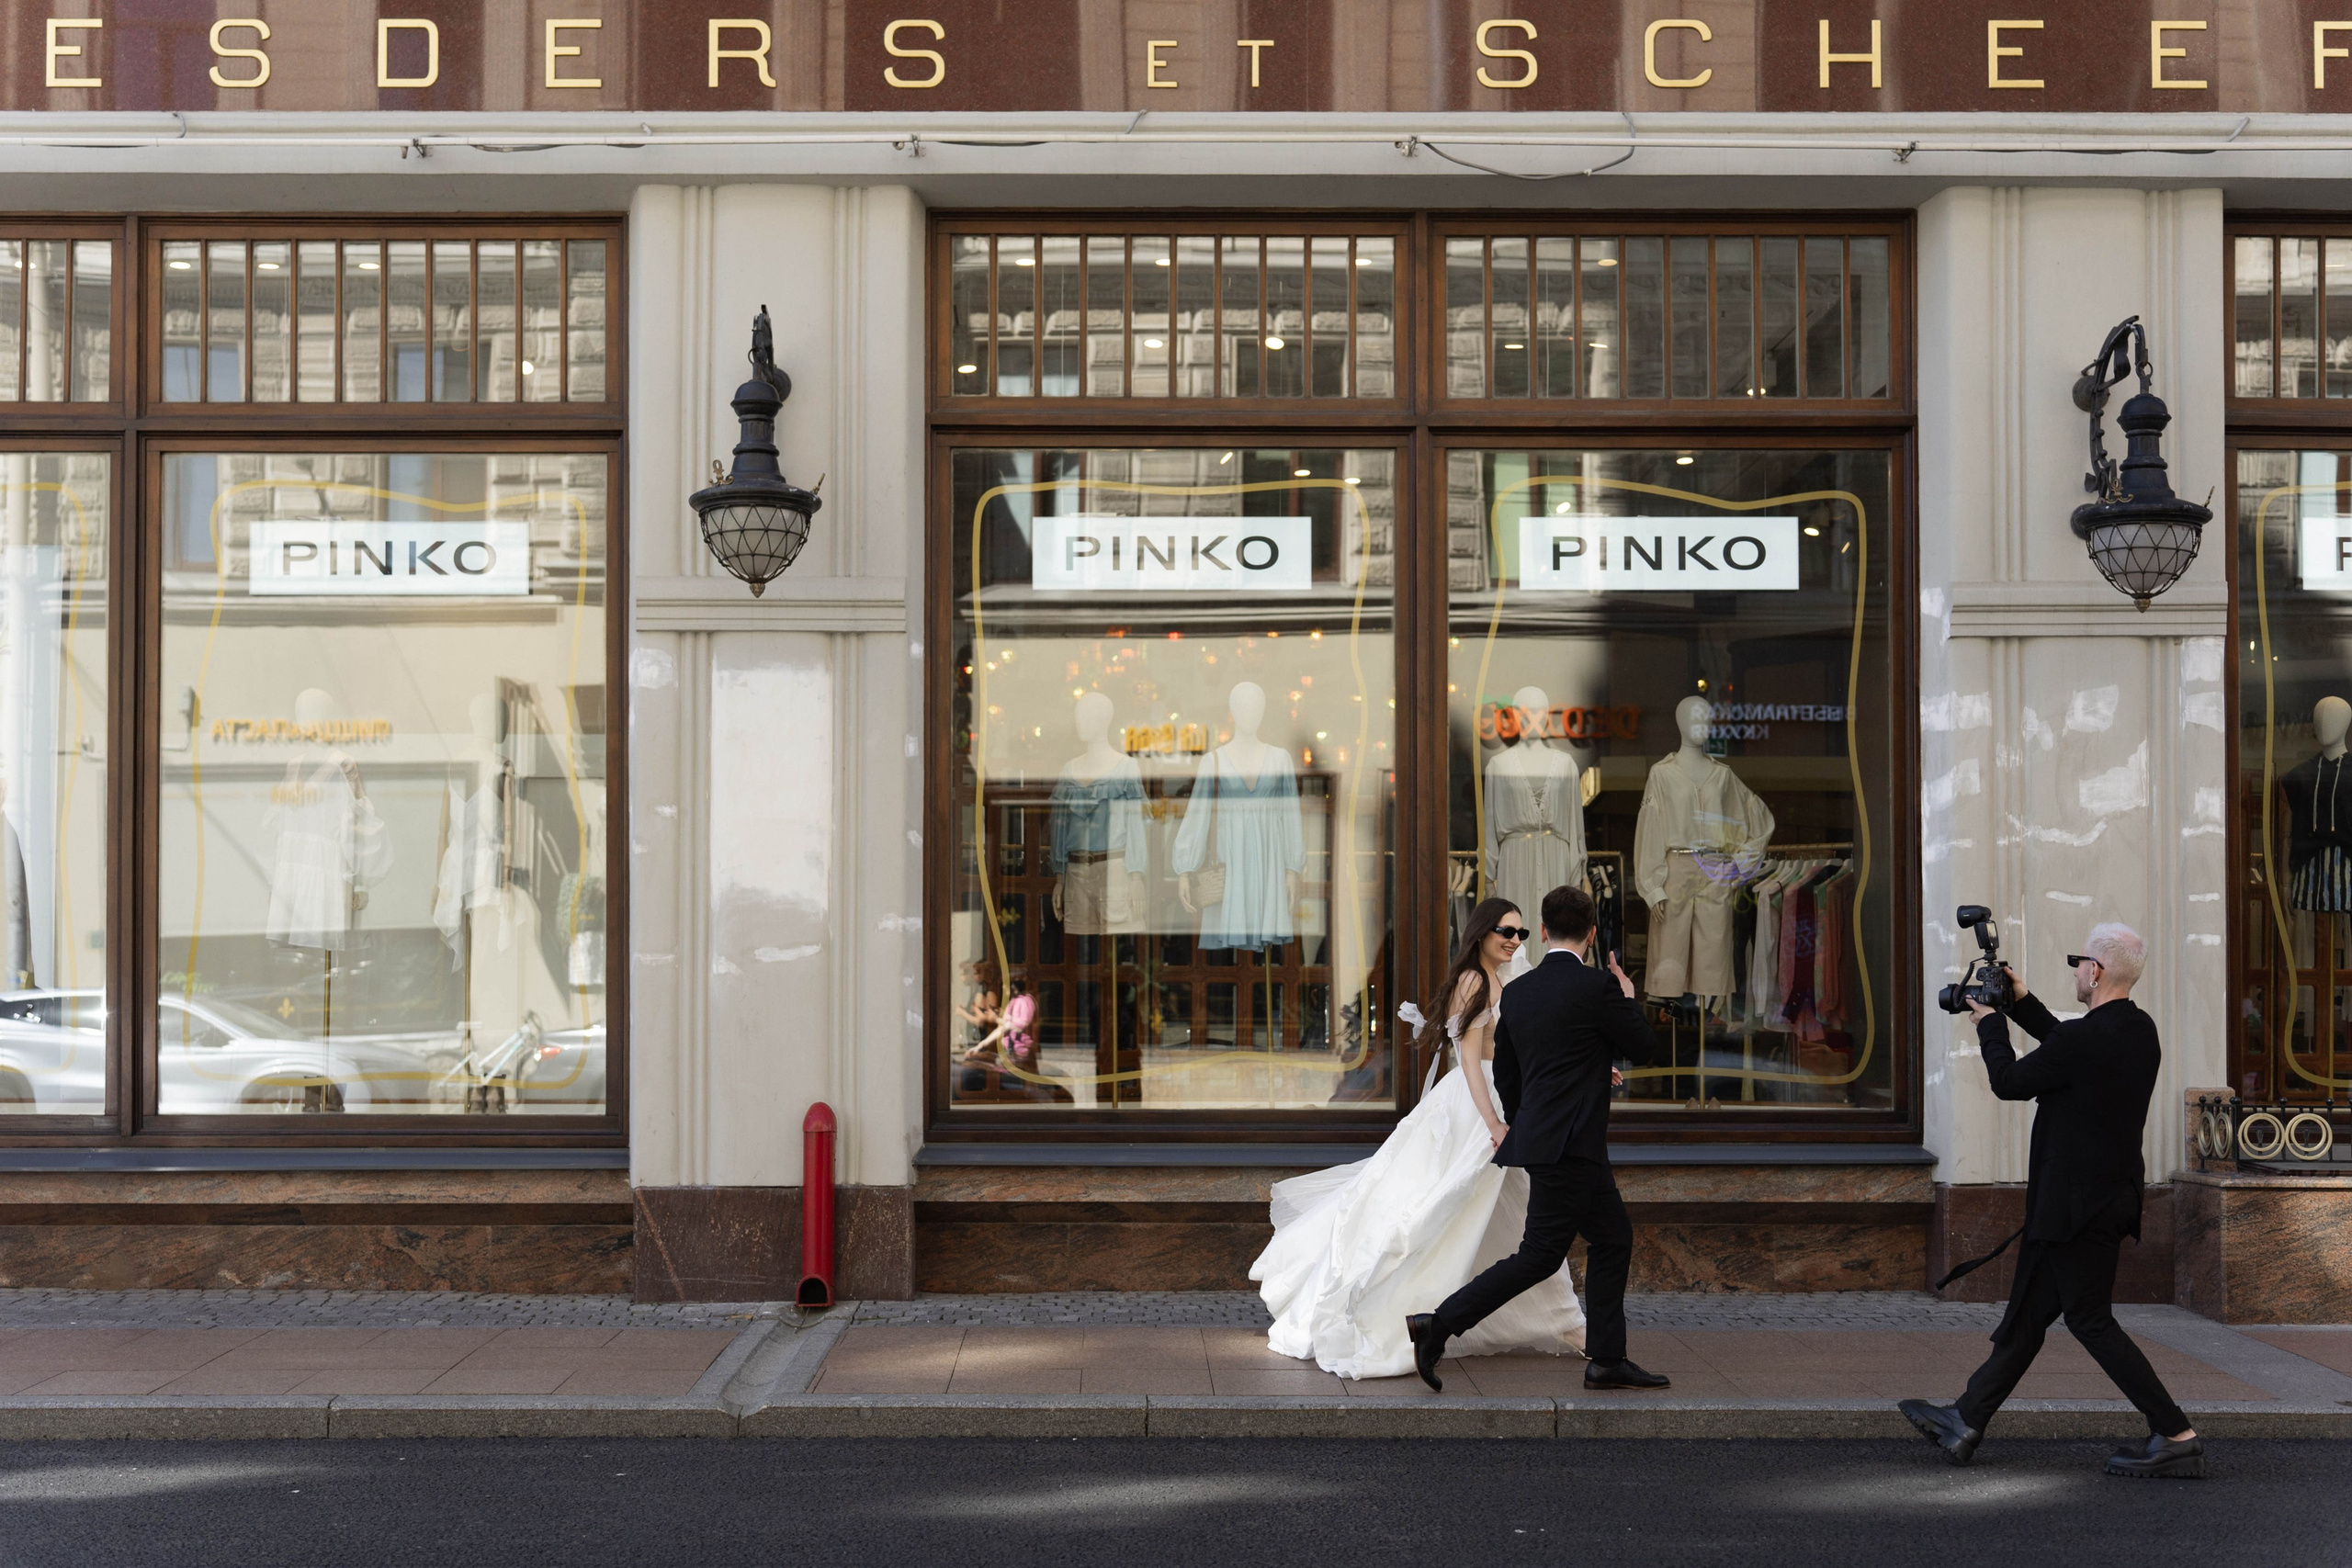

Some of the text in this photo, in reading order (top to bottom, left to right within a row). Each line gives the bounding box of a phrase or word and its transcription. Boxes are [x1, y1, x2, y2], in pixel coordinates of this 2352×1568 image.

[45, 17, 2352, 90] ESDERS ET SCHEEF
[282, 539, 498, 577] PINKO
[1065, 535, 1281, 571] PINKO
[1552, 535, 1768, 571] PINKO
